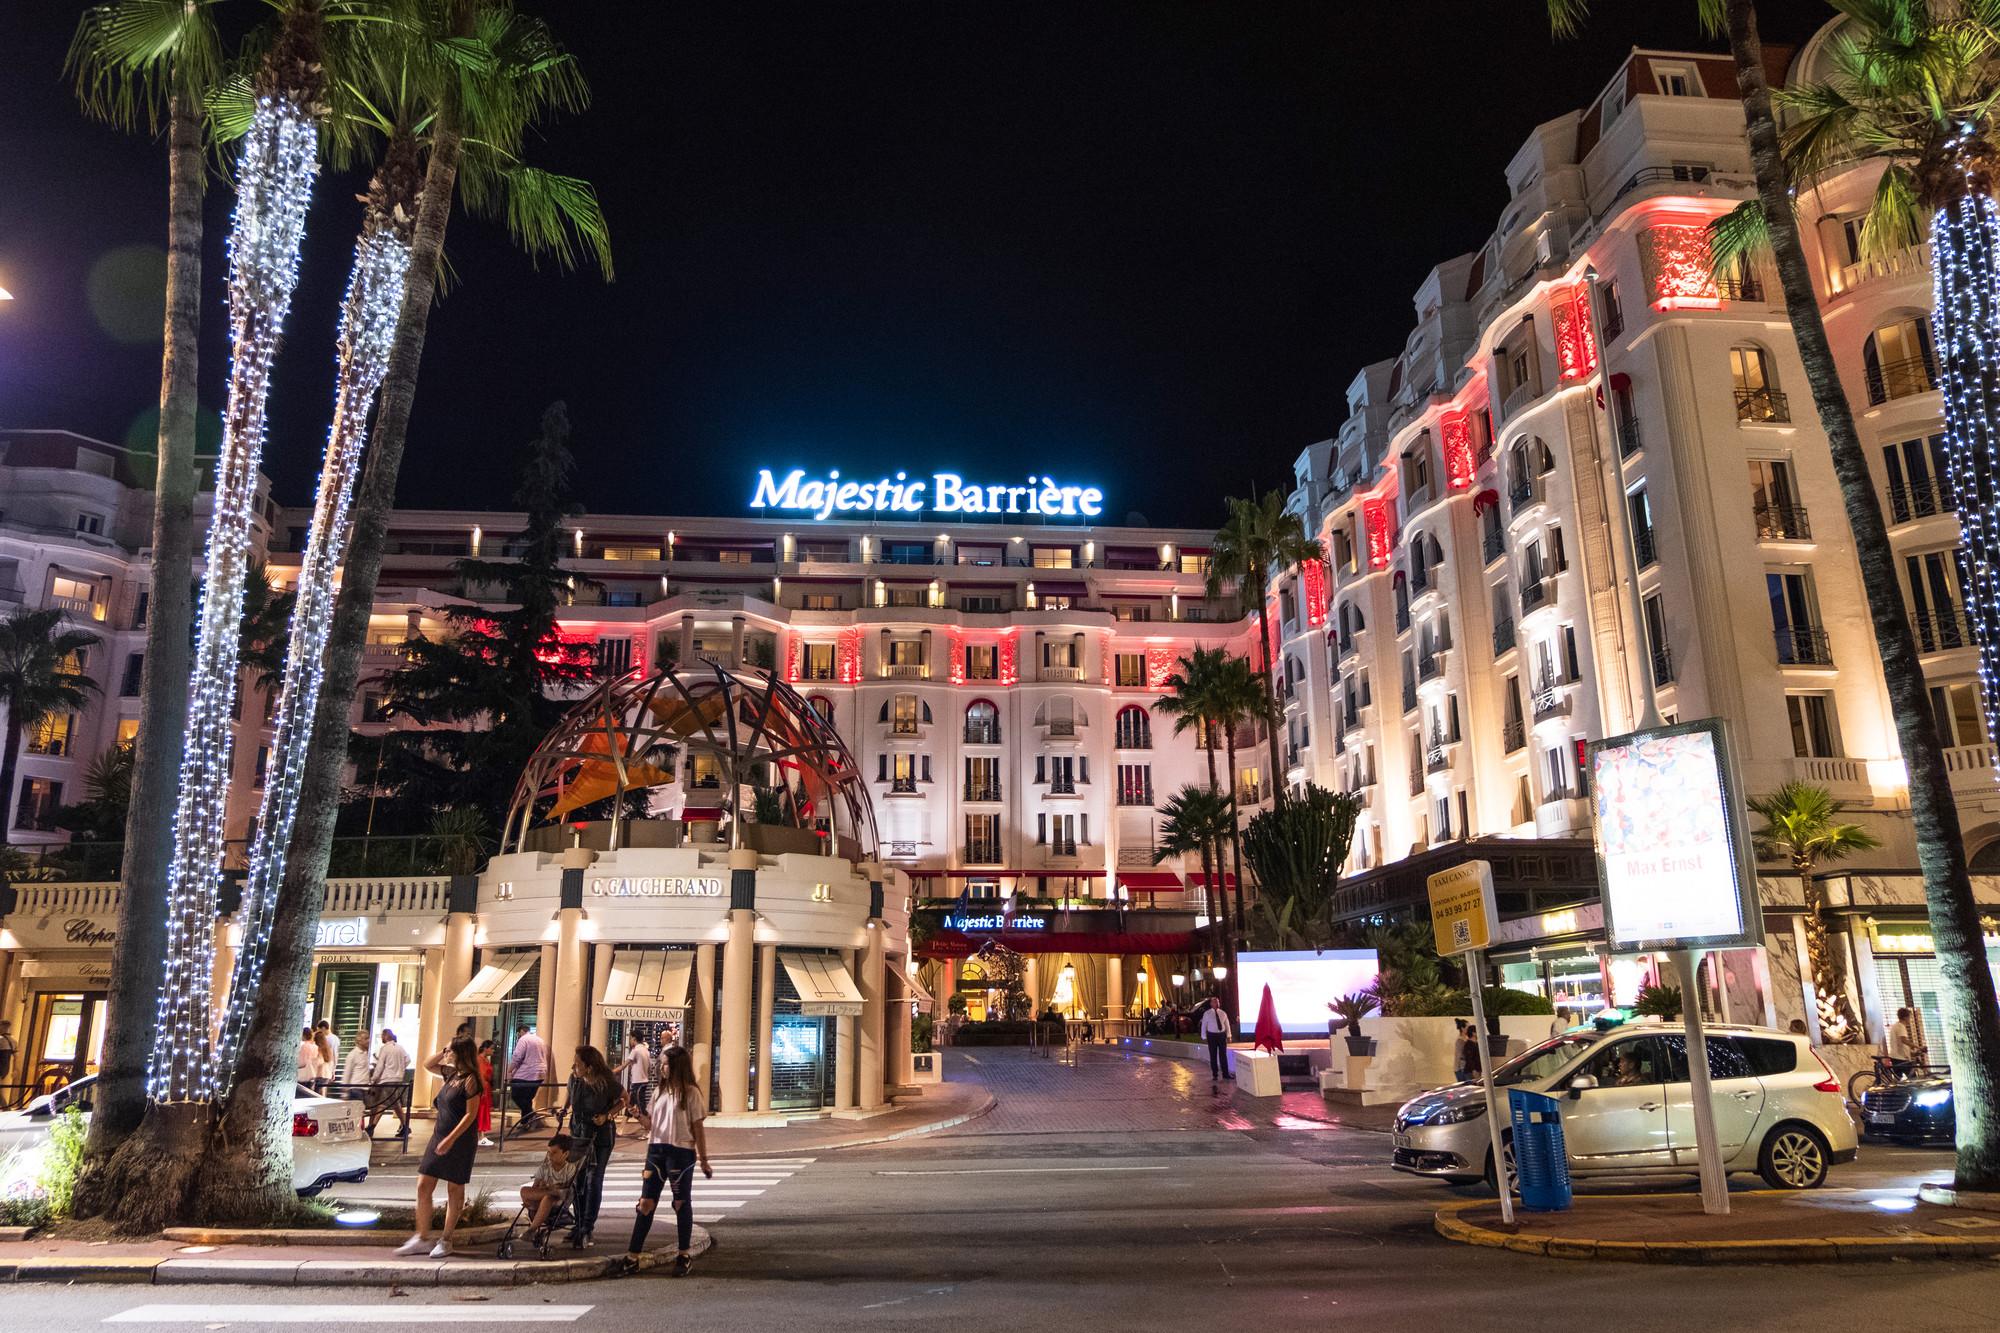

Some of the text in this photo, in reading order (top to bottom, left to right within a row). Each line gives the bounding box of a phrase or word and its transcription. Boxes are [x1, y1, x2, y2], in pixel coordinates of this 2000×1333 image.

[750, 469, 1103, 521] Majestic Barrière
[1627, 855, 1703, 877] Max Ernst
[607, 878, 720, 895] GAUCHERAND
[1435, 898, 1480, 919] 04 93 99 27 27
[63, 918, 116, 946] Chopa
[320, 955, 351, 963] ROLEX
[615, 1007, 682, 1019] GAUCHERAND
